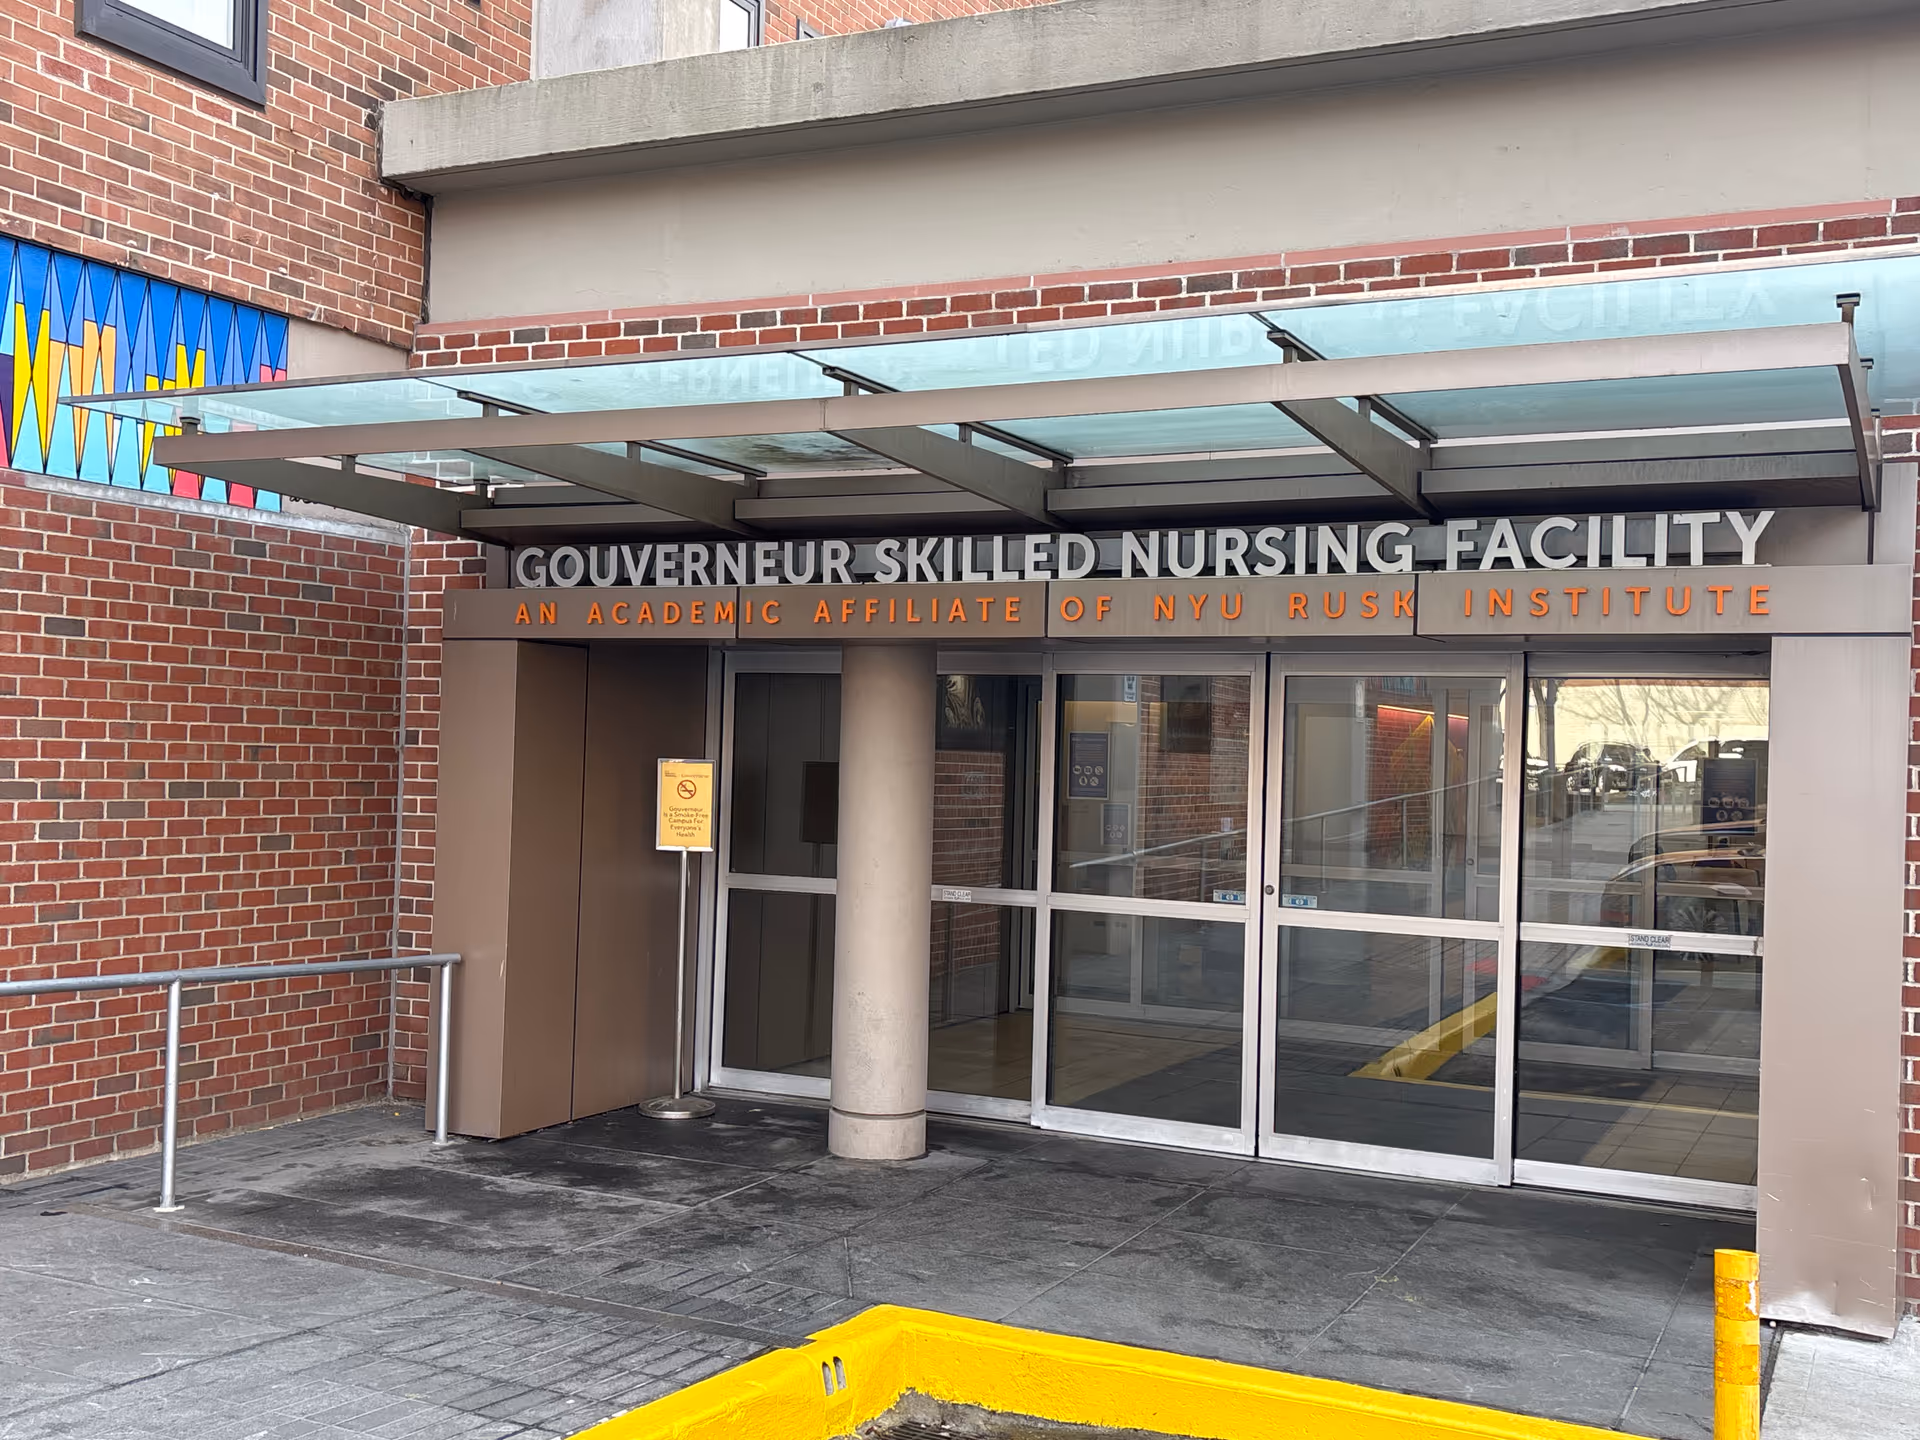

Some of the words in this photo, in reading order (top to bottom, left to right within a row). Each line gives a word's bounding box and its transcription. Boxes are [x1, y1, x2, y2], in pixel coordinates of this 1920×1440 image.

[515, 540, 853, 587] GOUVERNEUR
[874, 533, 1096, 584] SKILLED
[1121, 522, 1413, 579] NURSING
[1445, 510, 1775, 571] FACILITY
[514, 602, 556, 625] AN
[586, 599, 781, 625] ACADEMIC
[813, 596, 1020, 623] AFFILIATE
[1059, 595, 1111, 622] OF
[1153, 594, 1242, 621] NYU
[1288, 590, 1414, 619] RUSK
[1464, 585, 1770, 617] INSTITUTE
